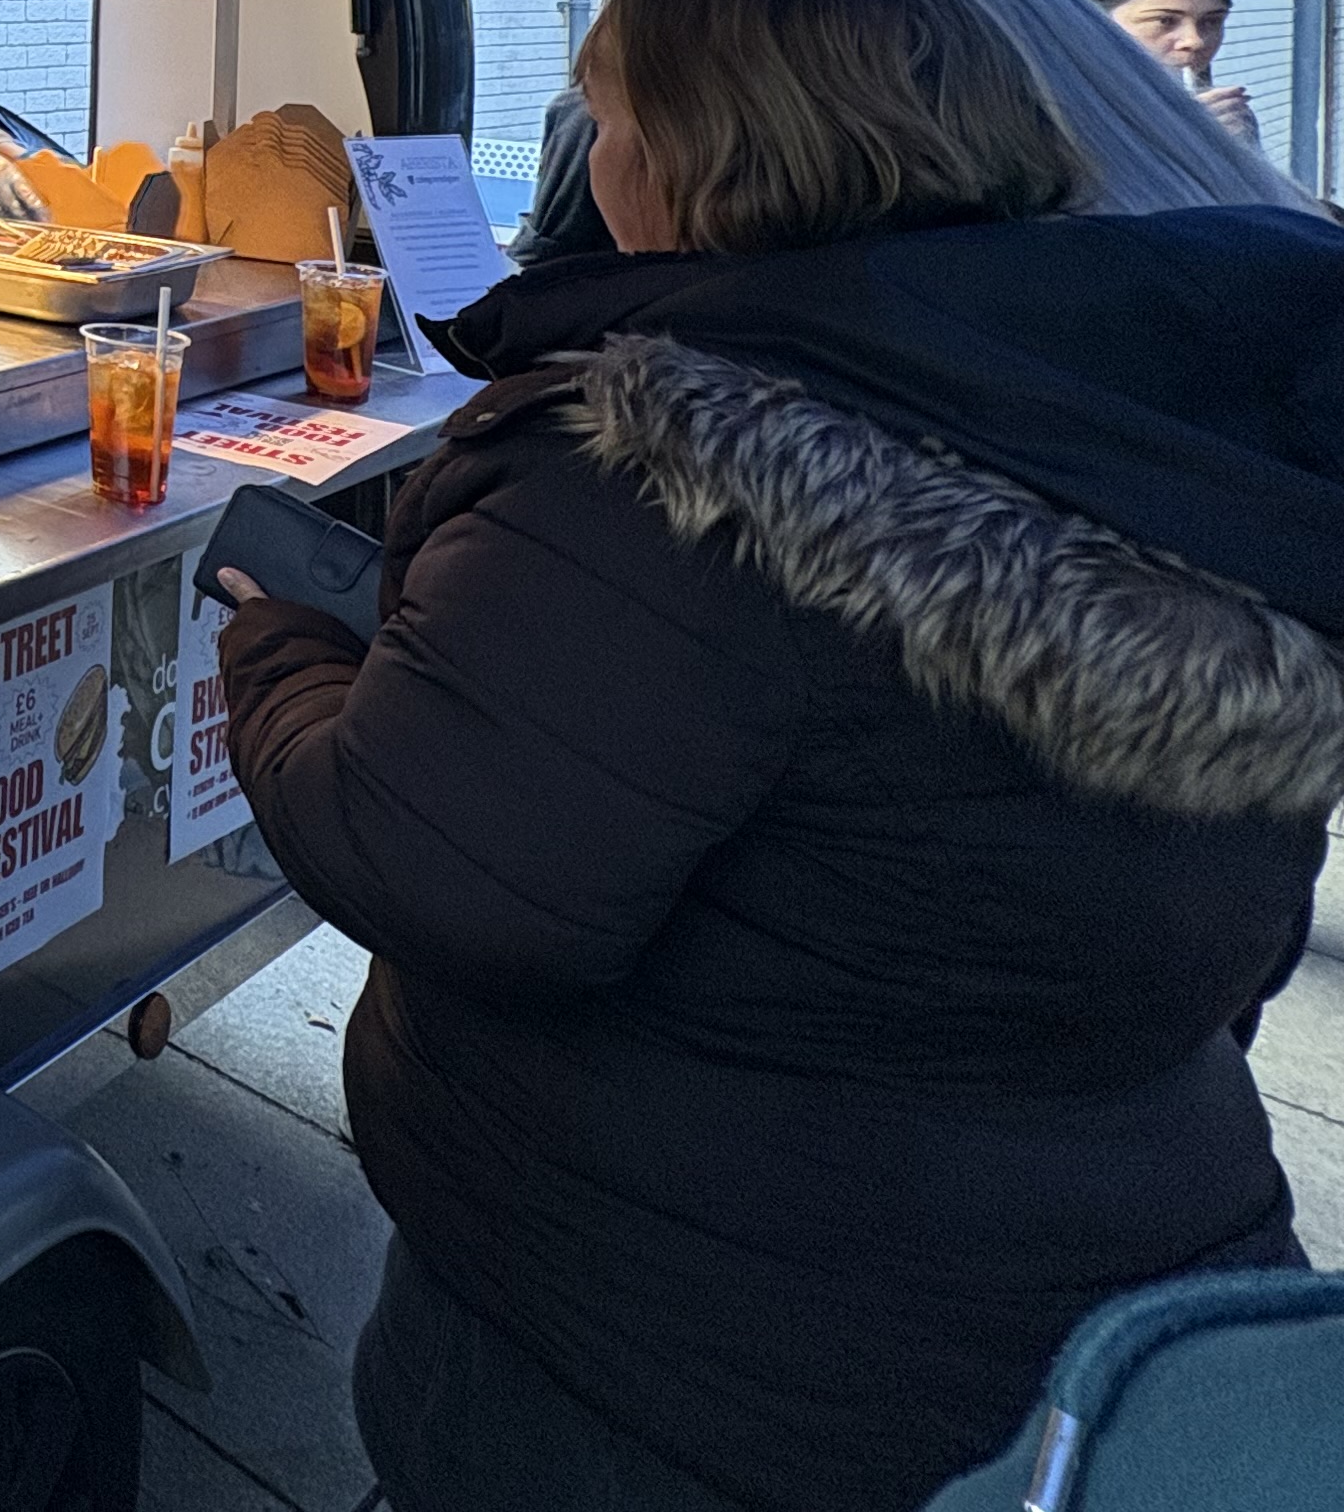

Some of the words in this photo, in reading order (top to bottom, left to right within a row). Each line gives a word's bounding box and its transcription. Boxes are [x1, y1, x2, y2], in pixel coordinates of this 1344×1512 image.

[214, 402, 365, 439] FESTIVAL
[254, 422, 352, 447] FOOD
[175, 430, 314, 465] STREET
[16, 688, 36, 716] £6
[192, 674, 228, 725] BW
[11, 727, 42, 753] DRINK
[190, 721, 229, 776] STR
